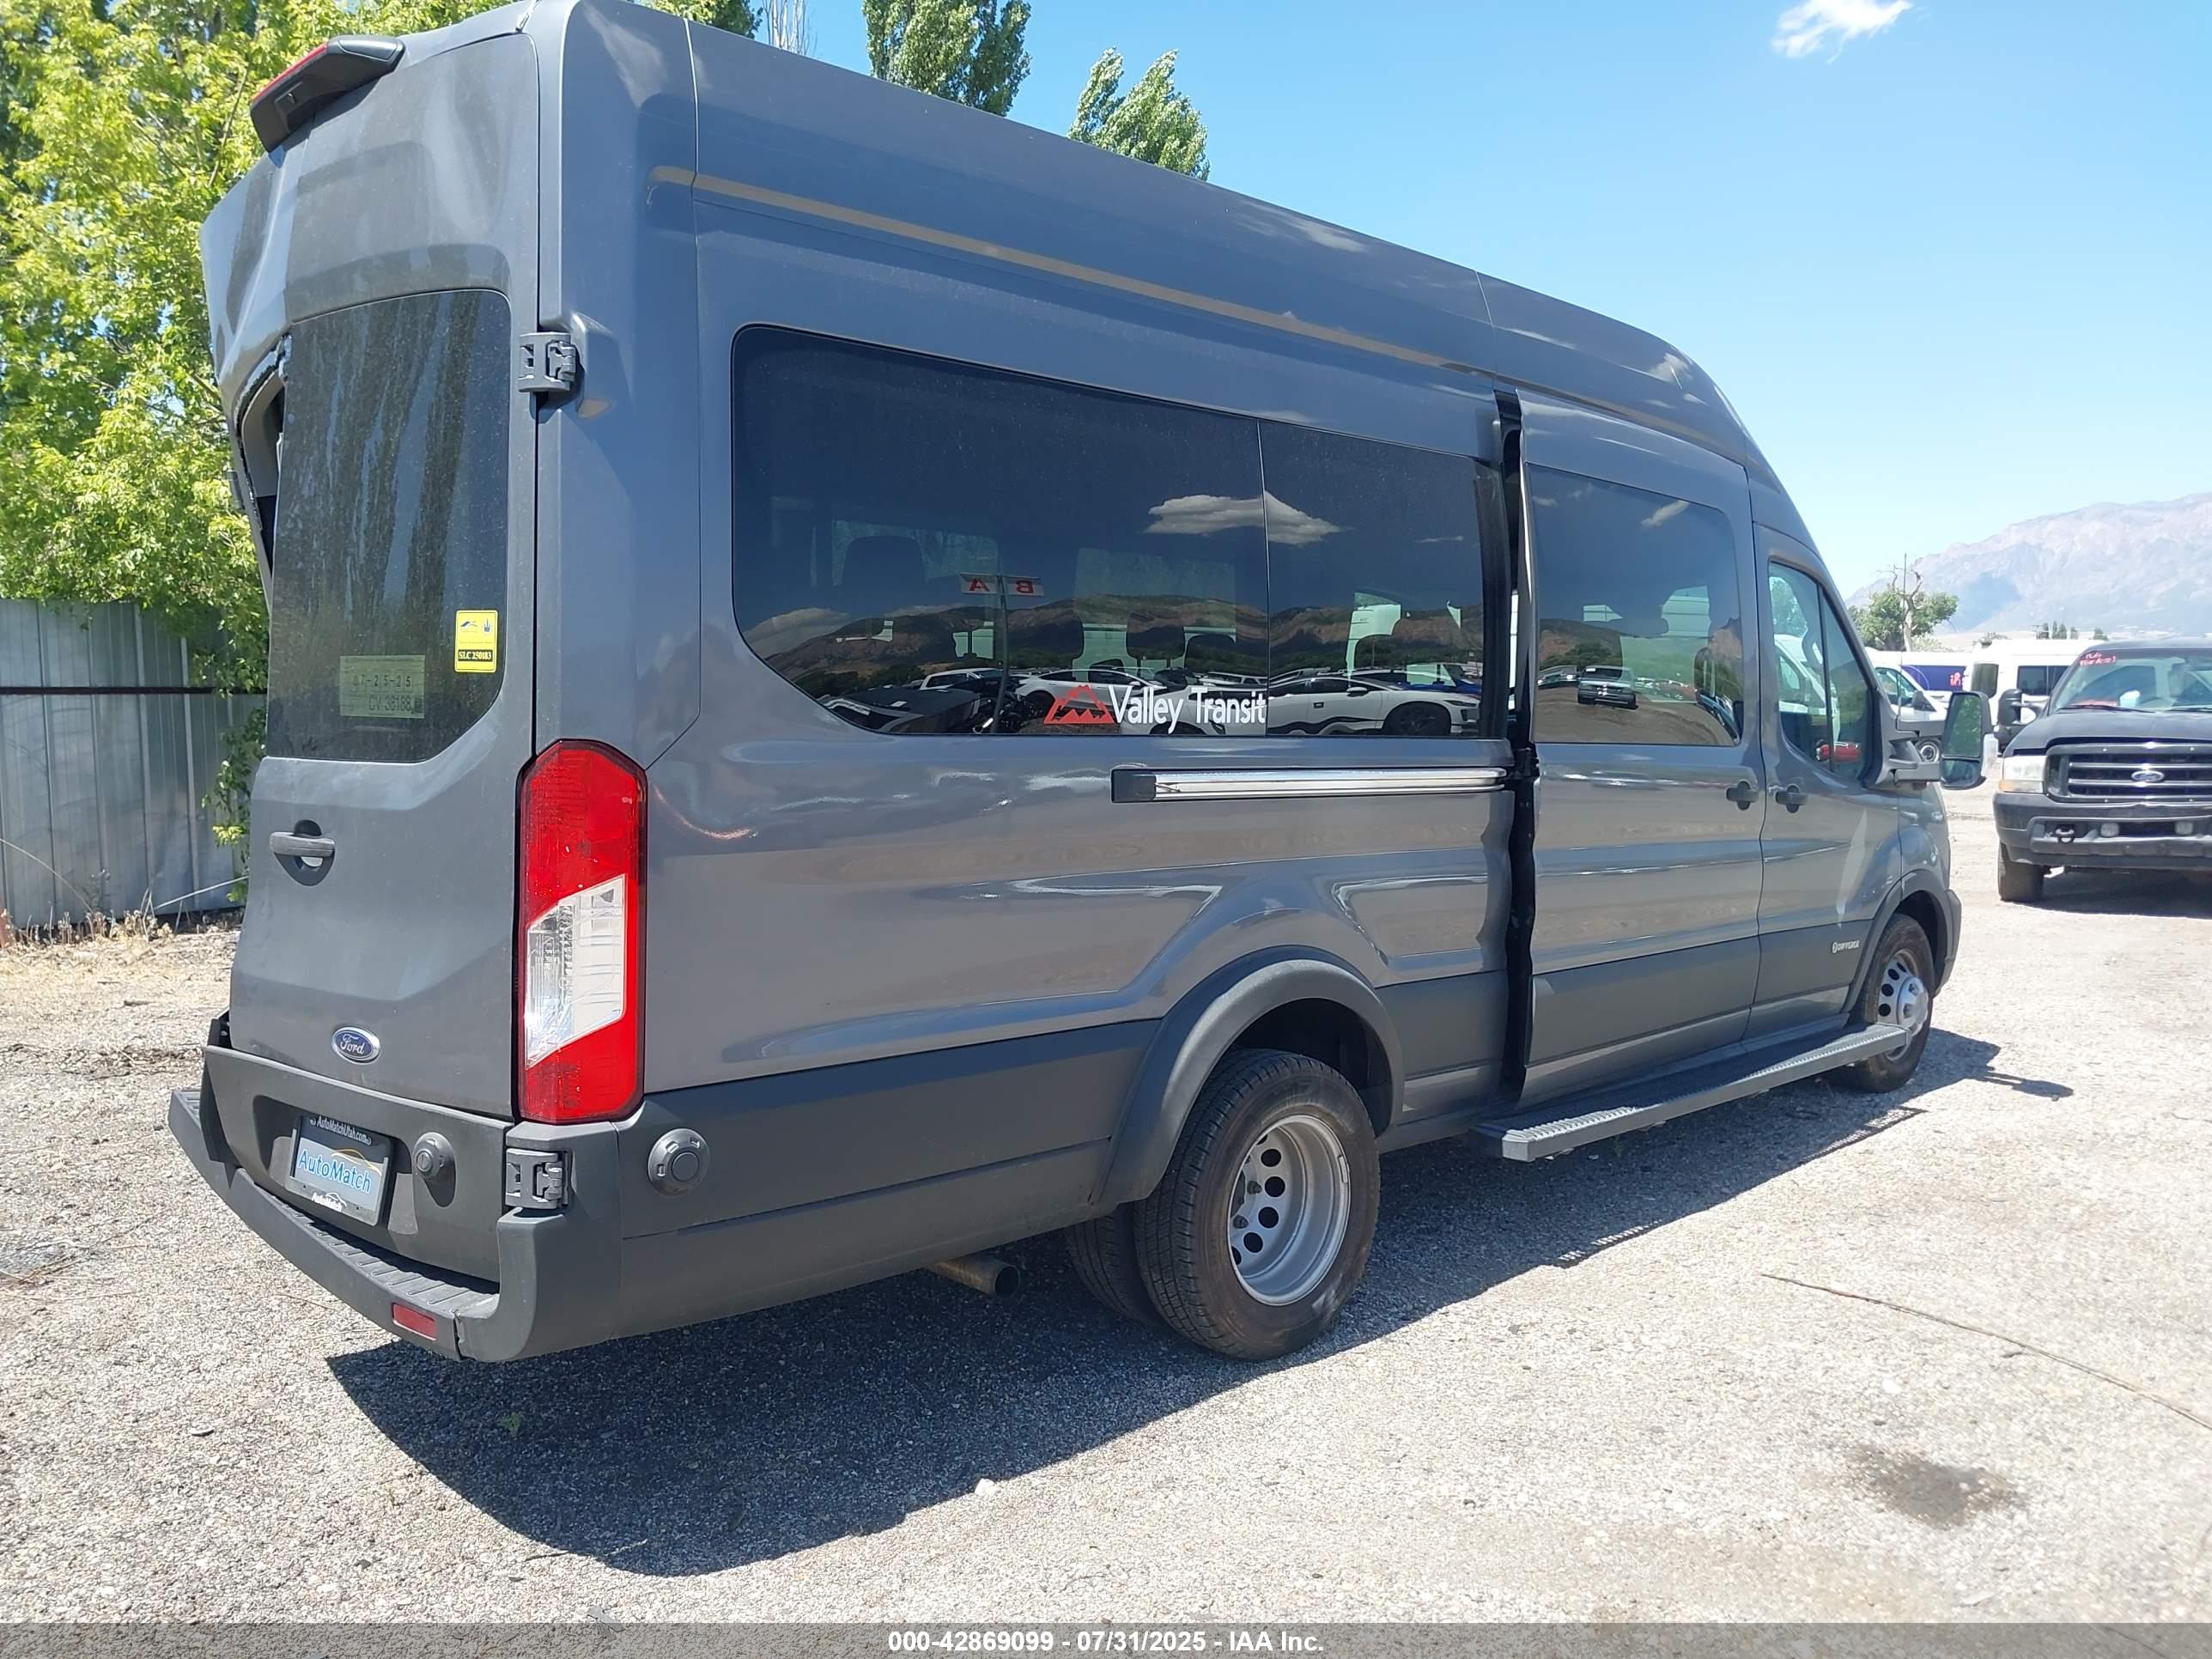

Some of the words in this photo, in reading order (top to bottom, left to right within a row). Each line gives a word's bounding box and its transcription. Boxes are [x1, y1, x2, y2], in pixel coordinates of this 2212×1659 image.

[1108, 684, 1184, 734] Valley
[1191, 687, 1266, 724] Transit
[340, 1033, 366, 1055] Ford
[316, 1115, 368, 1143] AutoMatchUtah.com
[296, 1150, 372, 1194] AutoMatch
[311, 1191, 343, 1212] AutoMatch
